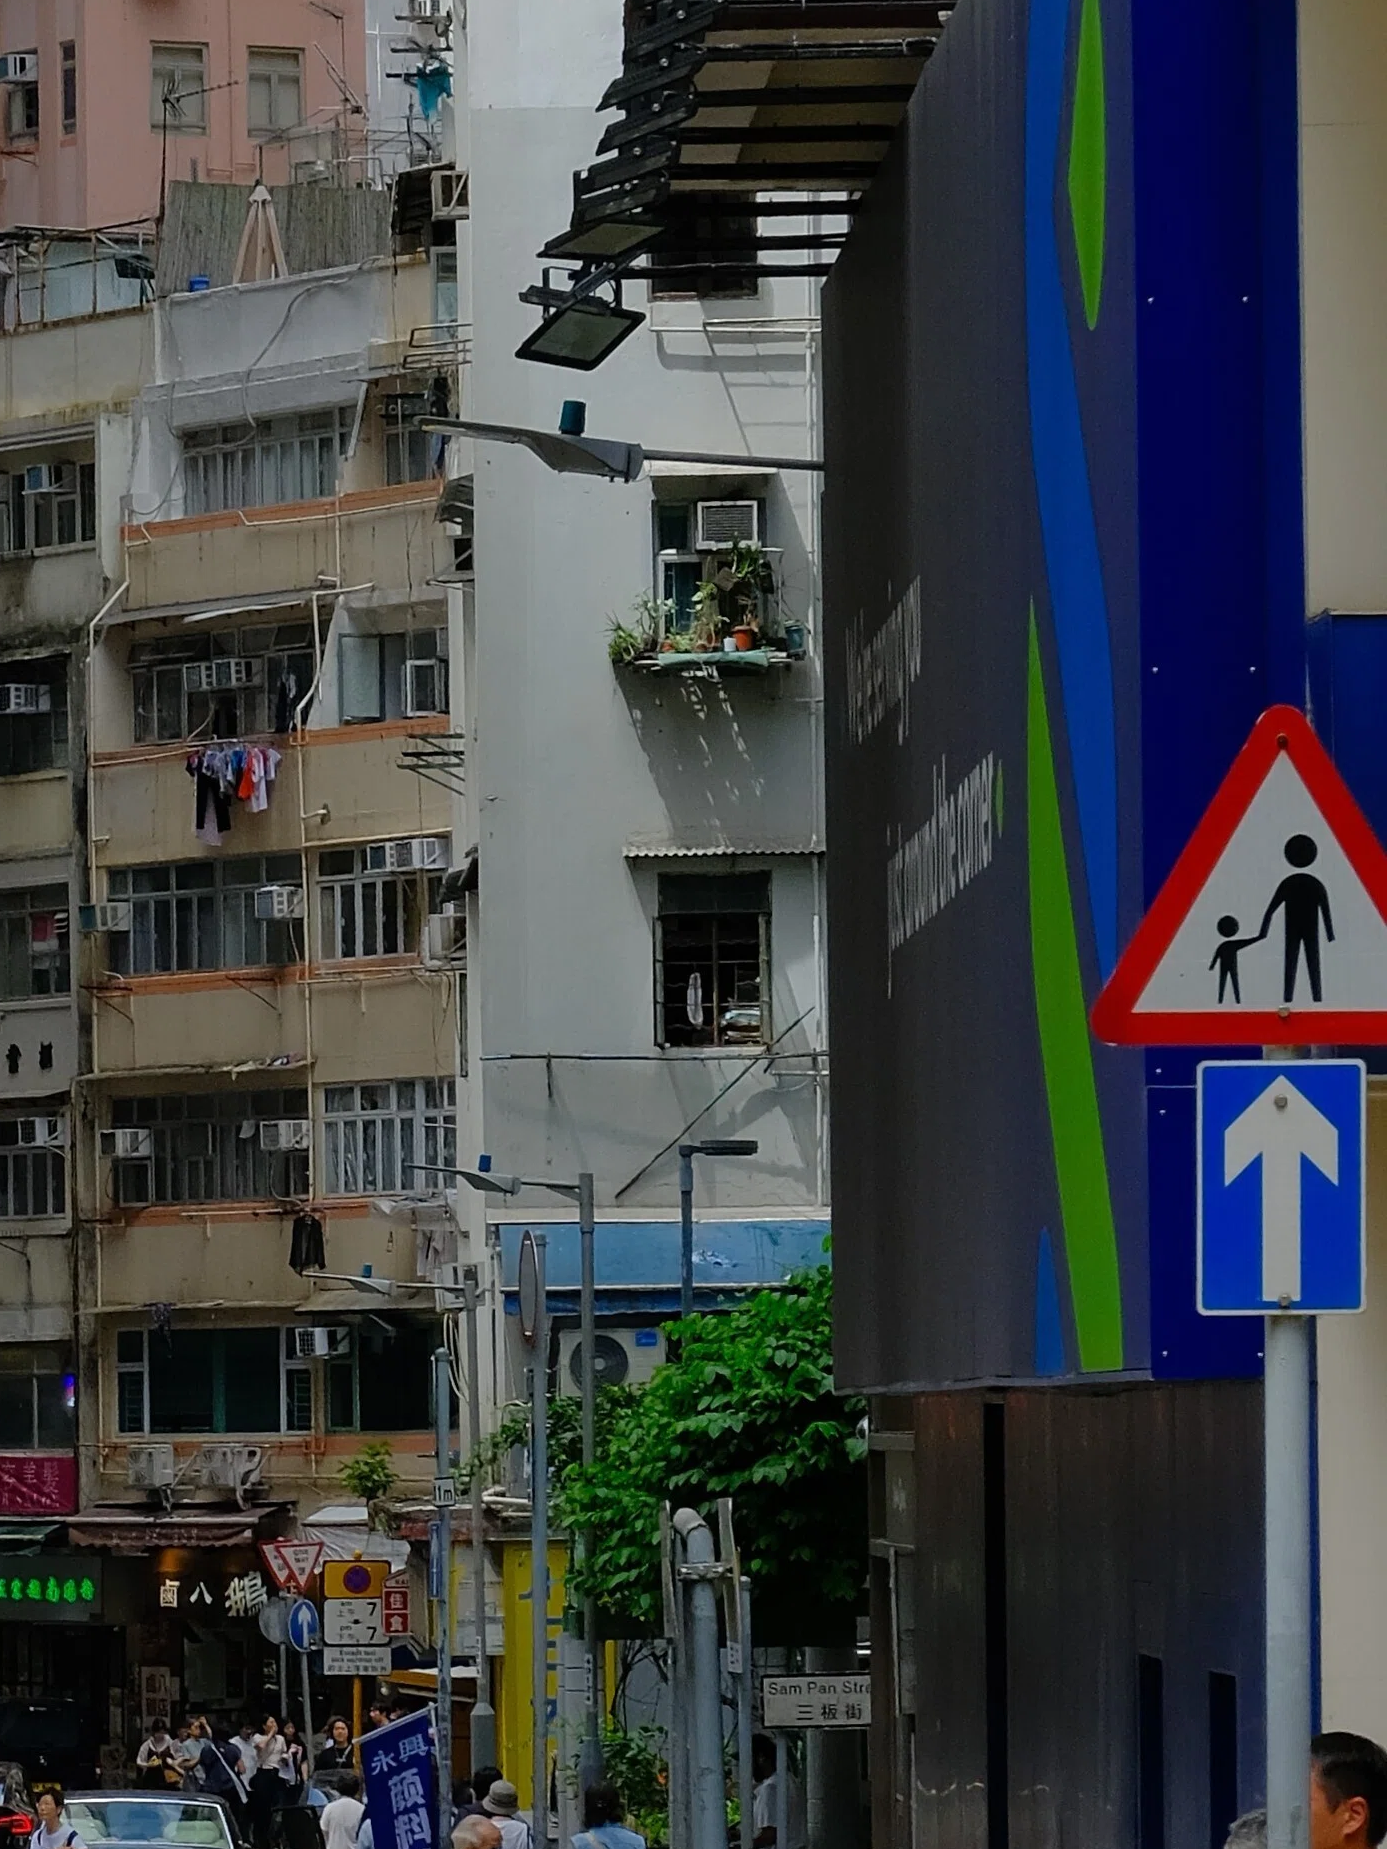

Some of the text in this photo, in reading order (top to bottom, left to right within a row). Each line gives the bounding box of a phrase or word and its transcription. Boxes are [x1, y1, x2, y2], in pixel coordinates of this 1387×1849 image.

[938, 753, 957, 909] the
[957, 750, 993, 890] corner
[366, 1602, 378, 1616] 7
[366, 1627, 378, 1641] 7
[769, 1680, 871, 1695] Sam Pan Str
[796, 1702, 862, 1720] 三板街
[371, 1733, 430, 1776] 永興
